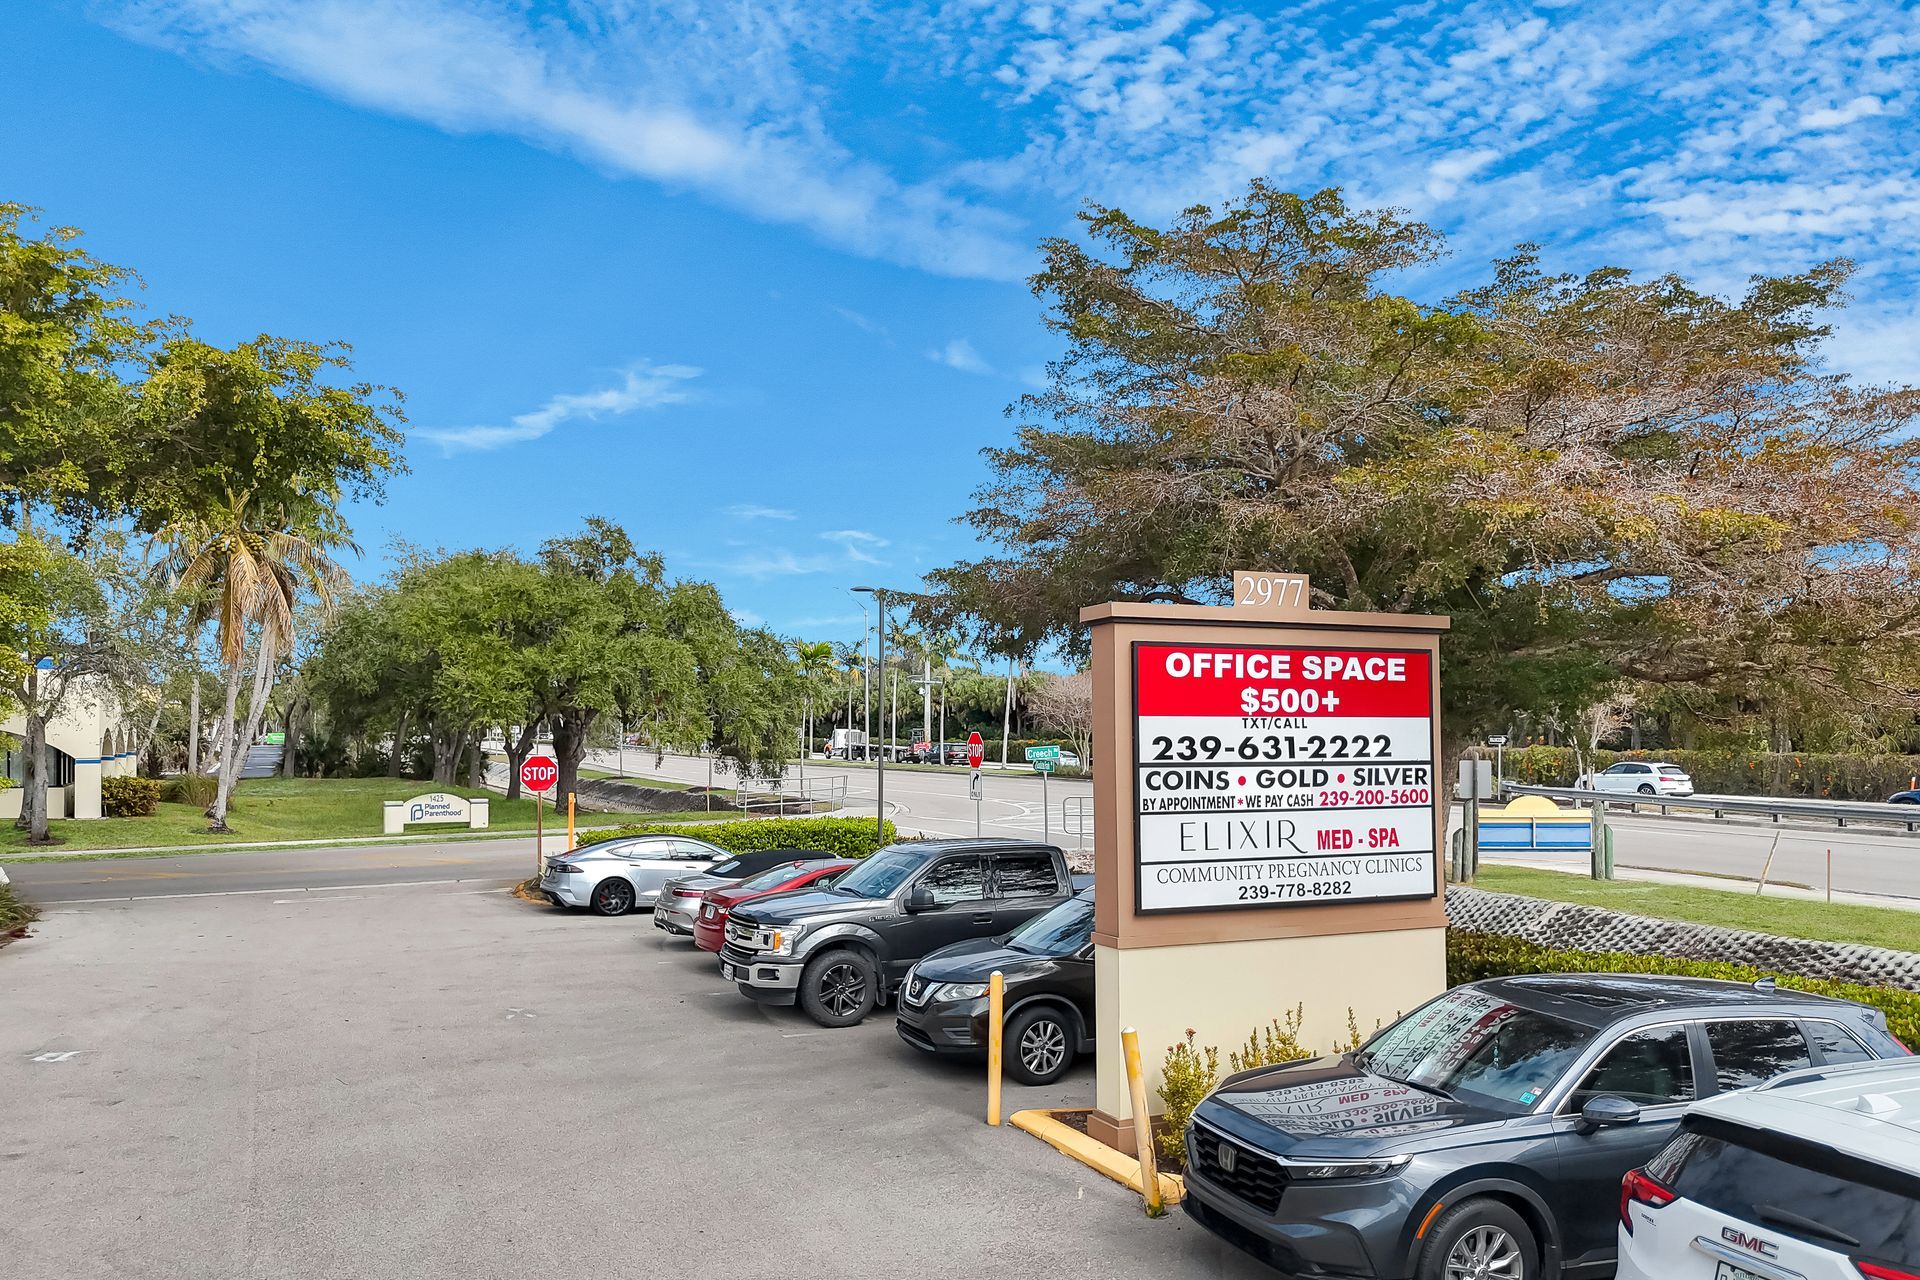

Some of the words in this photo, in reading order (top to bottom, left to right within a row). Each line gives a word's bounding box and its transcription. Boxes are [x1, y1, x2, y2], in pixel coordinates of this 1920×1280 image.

[1240, 576, 1304, 607] 2977
[1165, 652, 1291, 679] OFFICE
[1301, 655, 1406, 682] SPACE
[1240, 686, 1340, 715] $500+
[1241, 717, 1308, 730] TXT/CALL
[968, 744, 983, 758] STOP
[1027, 748, 1053, 759] Creech
[1151, 734, 1393, 761] 239-631-2222
[523, 766, 556, 781] STOP
[1145, 770, 1230, 791] COINS
[1255, 769, 1329, 789] GOLD
[1353, 767, 1428, 787] SILVER
[430, 794, 444, 803] 1425
[1142, 798, 1156, 811] BY
[1159, 796, 1236, 811] APPOINTMENT
[1245, 795, 1262, 808] WE
[1265, 794, 1284, 808] PAY
[1286, 793, 1314, 807] CASH
[1319, 788, 1429, 806] 239-200-5600
[1180, 819, 1308, 854] ELIXIR
[1317, 829, 1354, 850] MED
[1368, 827, 1400, 849] SPA
[1157, 864, 1264, 884] COMMUNITY
[1268, 859, 1362, 879] PREGNANCY
[1365, 857, 1423, 874] CLINICS
[1238, 880, 1352, 900] 239-778-8282
[1721, 1226, 1779, 1260] GMC
